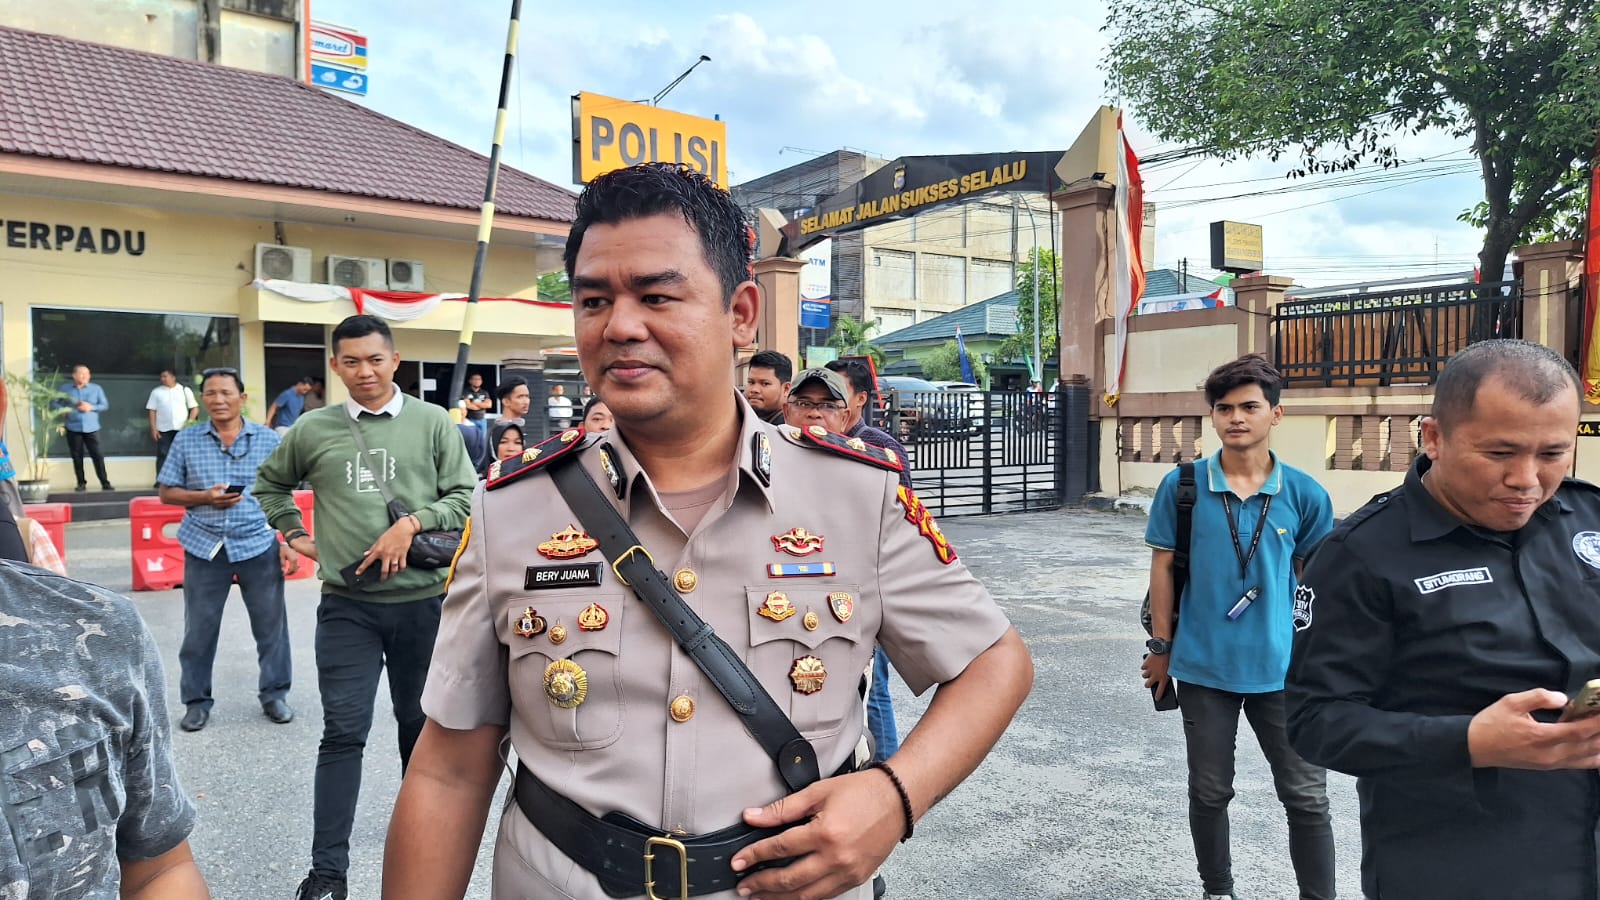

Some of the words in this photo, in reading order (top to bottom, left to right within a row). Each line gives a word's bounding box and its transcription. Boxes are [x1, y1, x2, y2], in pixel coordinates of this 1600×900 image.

[591, 115, 718, 182] POLISI
[800, 208, 855, 235] SELAMAT
[856, 196, 900, 221] JALAN
[900, 179, 958, 210] SUKSES
[960, 159, 1028, 194] SELALU
[0, 218, 146, 257] ERPADU
[536, 571, 560, 582] BERY
[560, 569, 590, 581] JUANA
